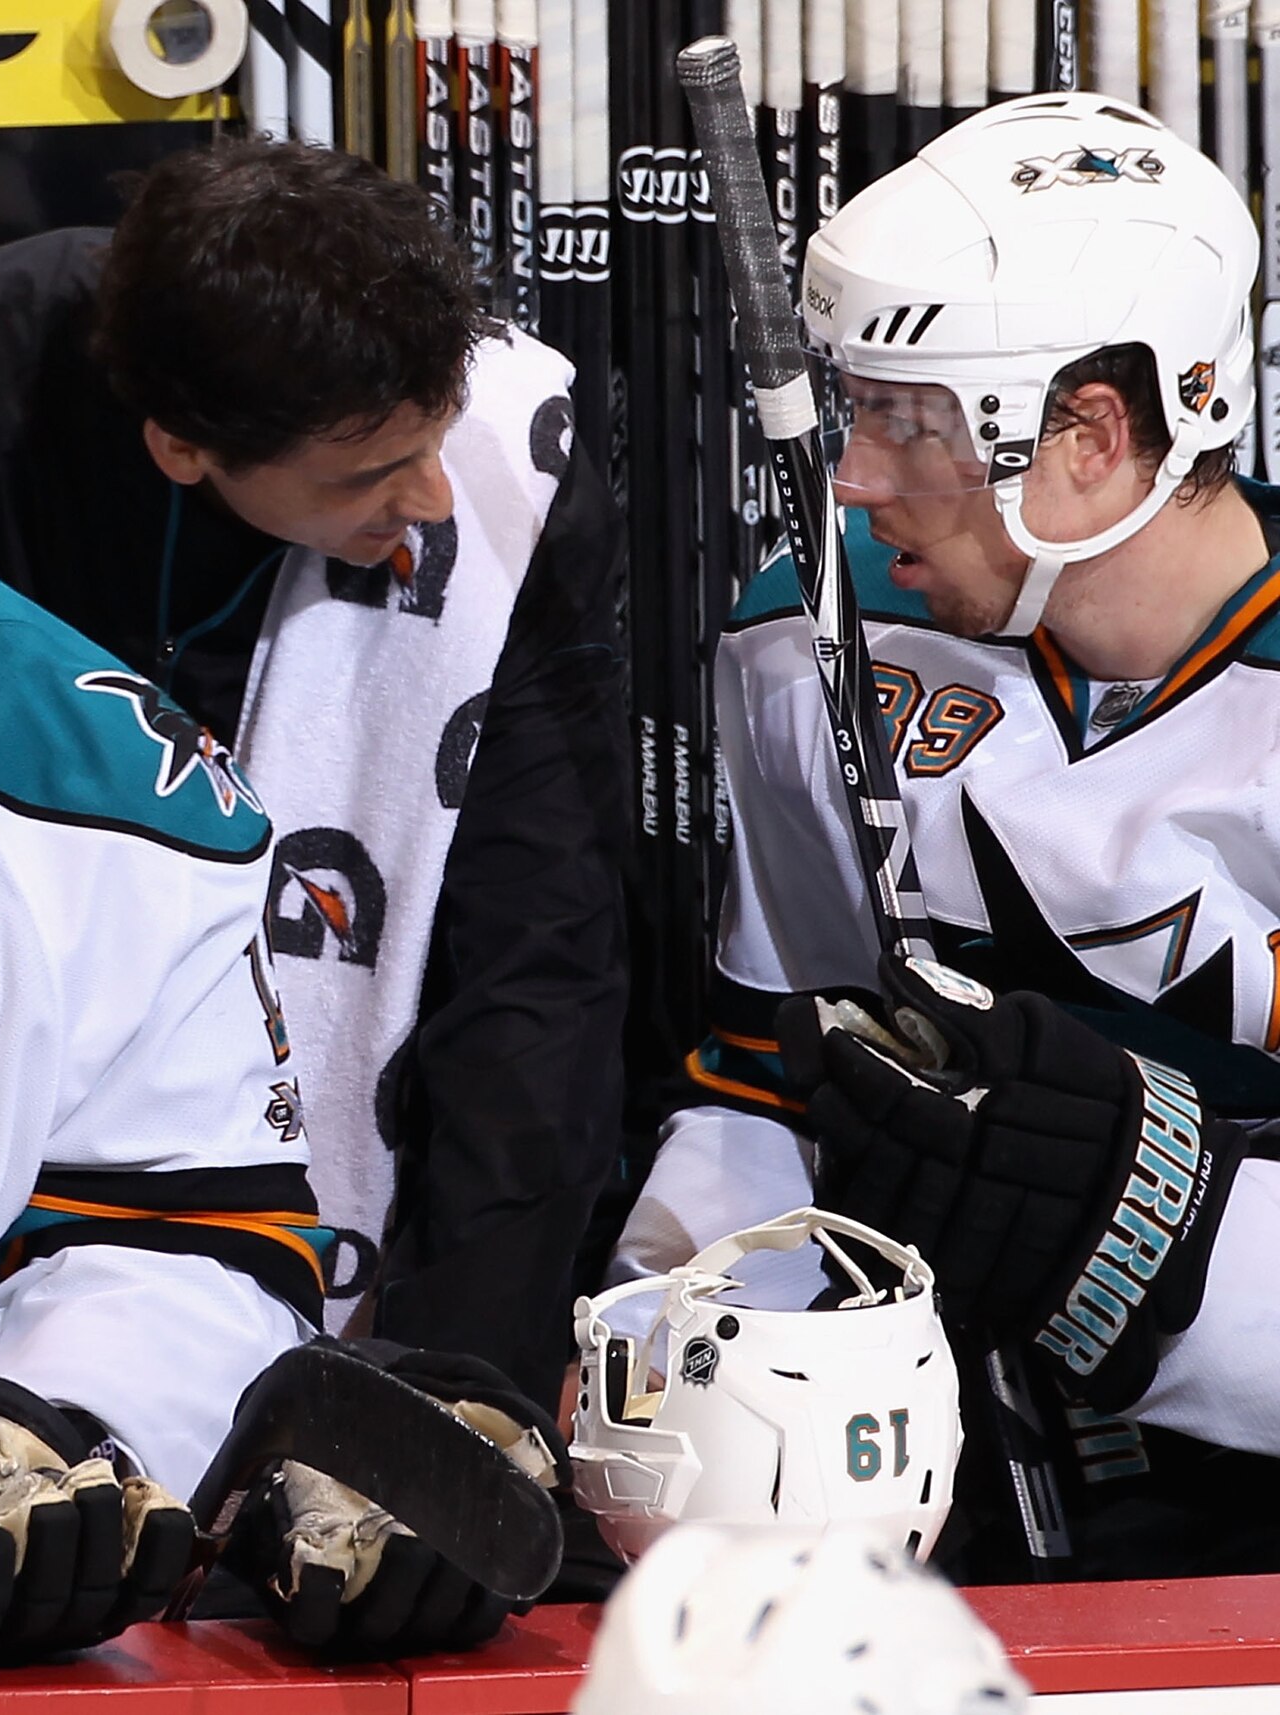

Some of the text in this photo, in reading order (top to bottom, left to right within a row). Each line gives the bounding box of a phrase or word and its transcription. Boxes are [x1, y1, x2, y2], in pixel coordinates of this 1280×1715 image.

[1058, 6, 1073, 86] CCM
[775, 452, 807, 564] COUTURE
[835, 728, 860, 787] 39
[1034, 1047, 1203, 1376] WARRIOR
